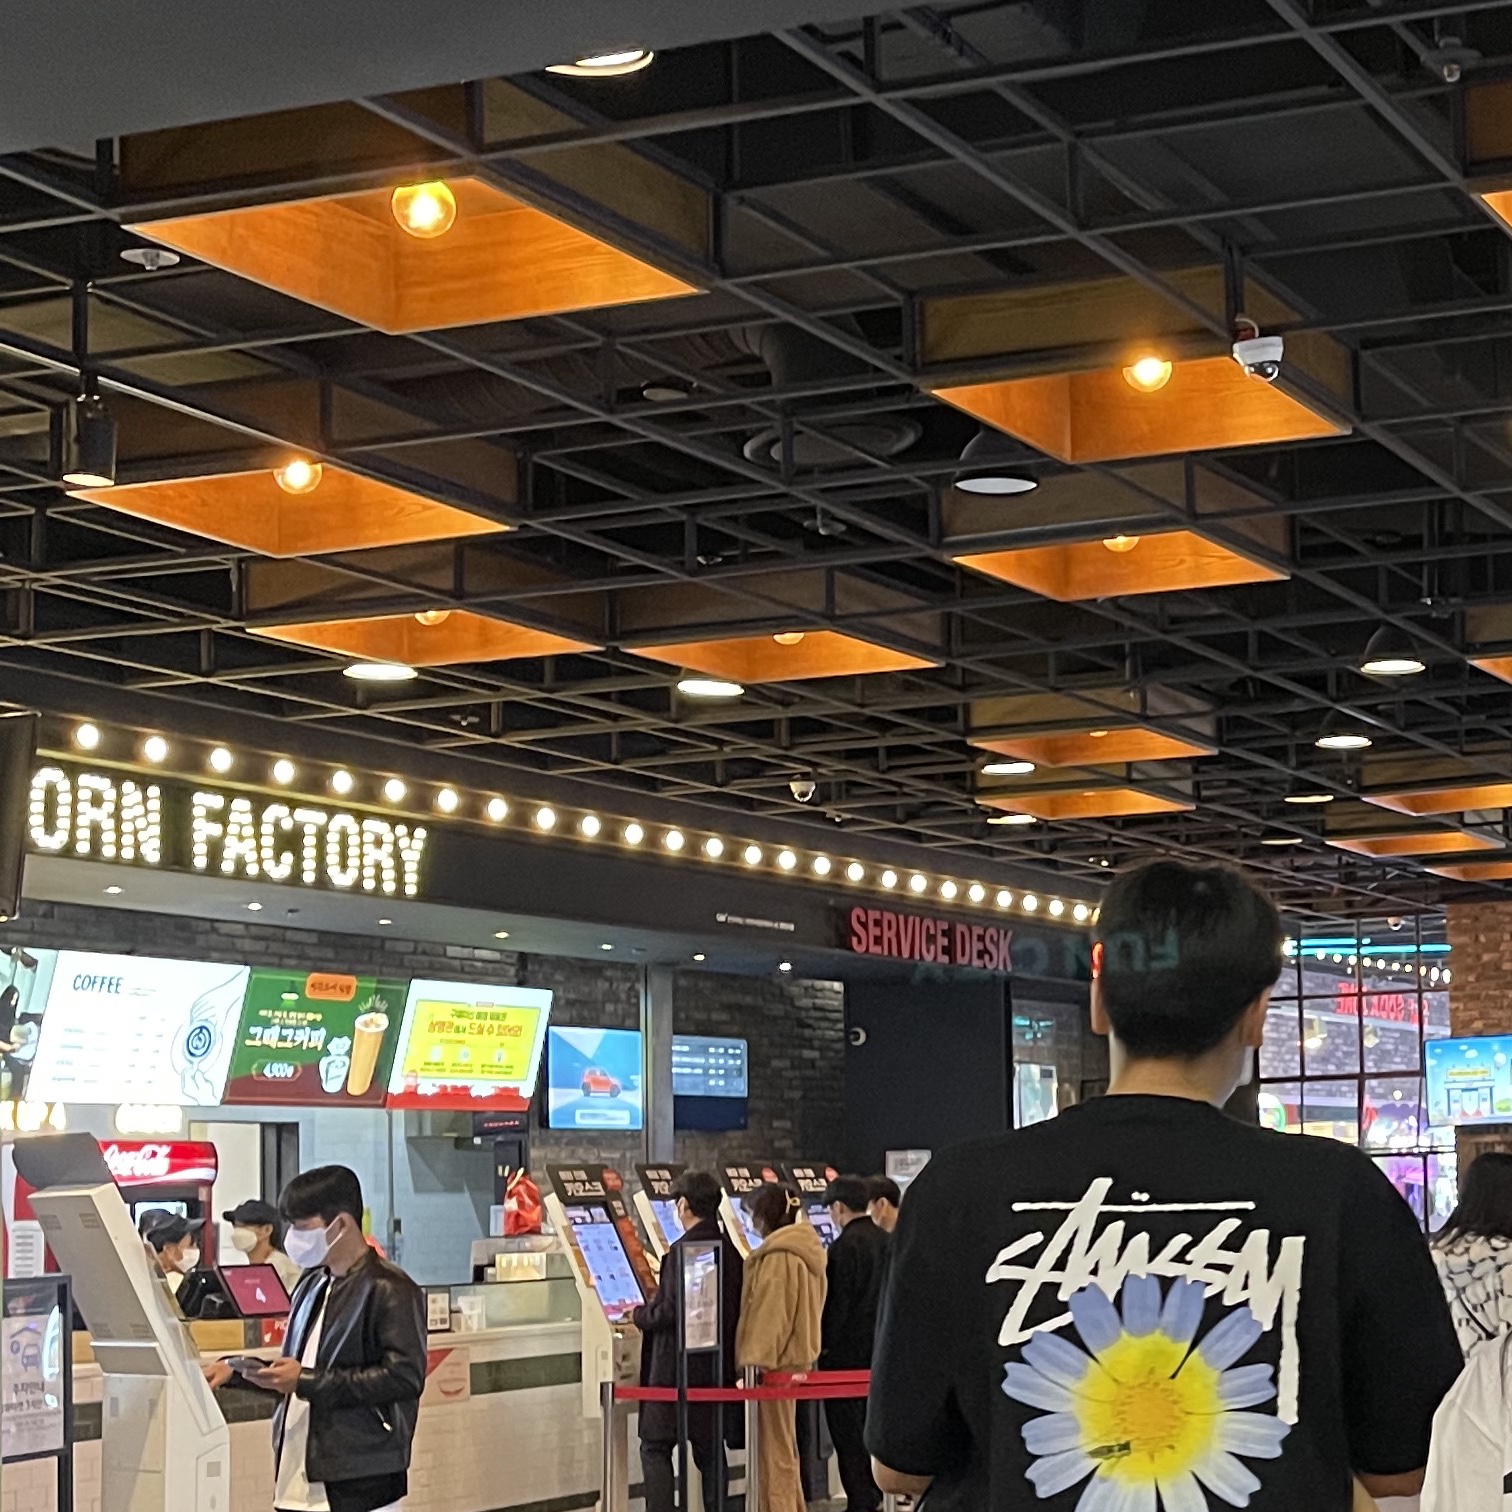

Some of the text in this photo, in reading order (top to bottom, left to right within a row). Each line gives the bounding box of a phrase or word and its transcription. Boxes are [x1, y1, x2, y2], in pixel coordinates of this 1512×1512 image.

[192, 791, 427, 896] FACTORY
[851, 906, 950, 964] SERVICE
[955, 922, 1013, 973] DESK
[73, 974, 124, 994] COFFEE
